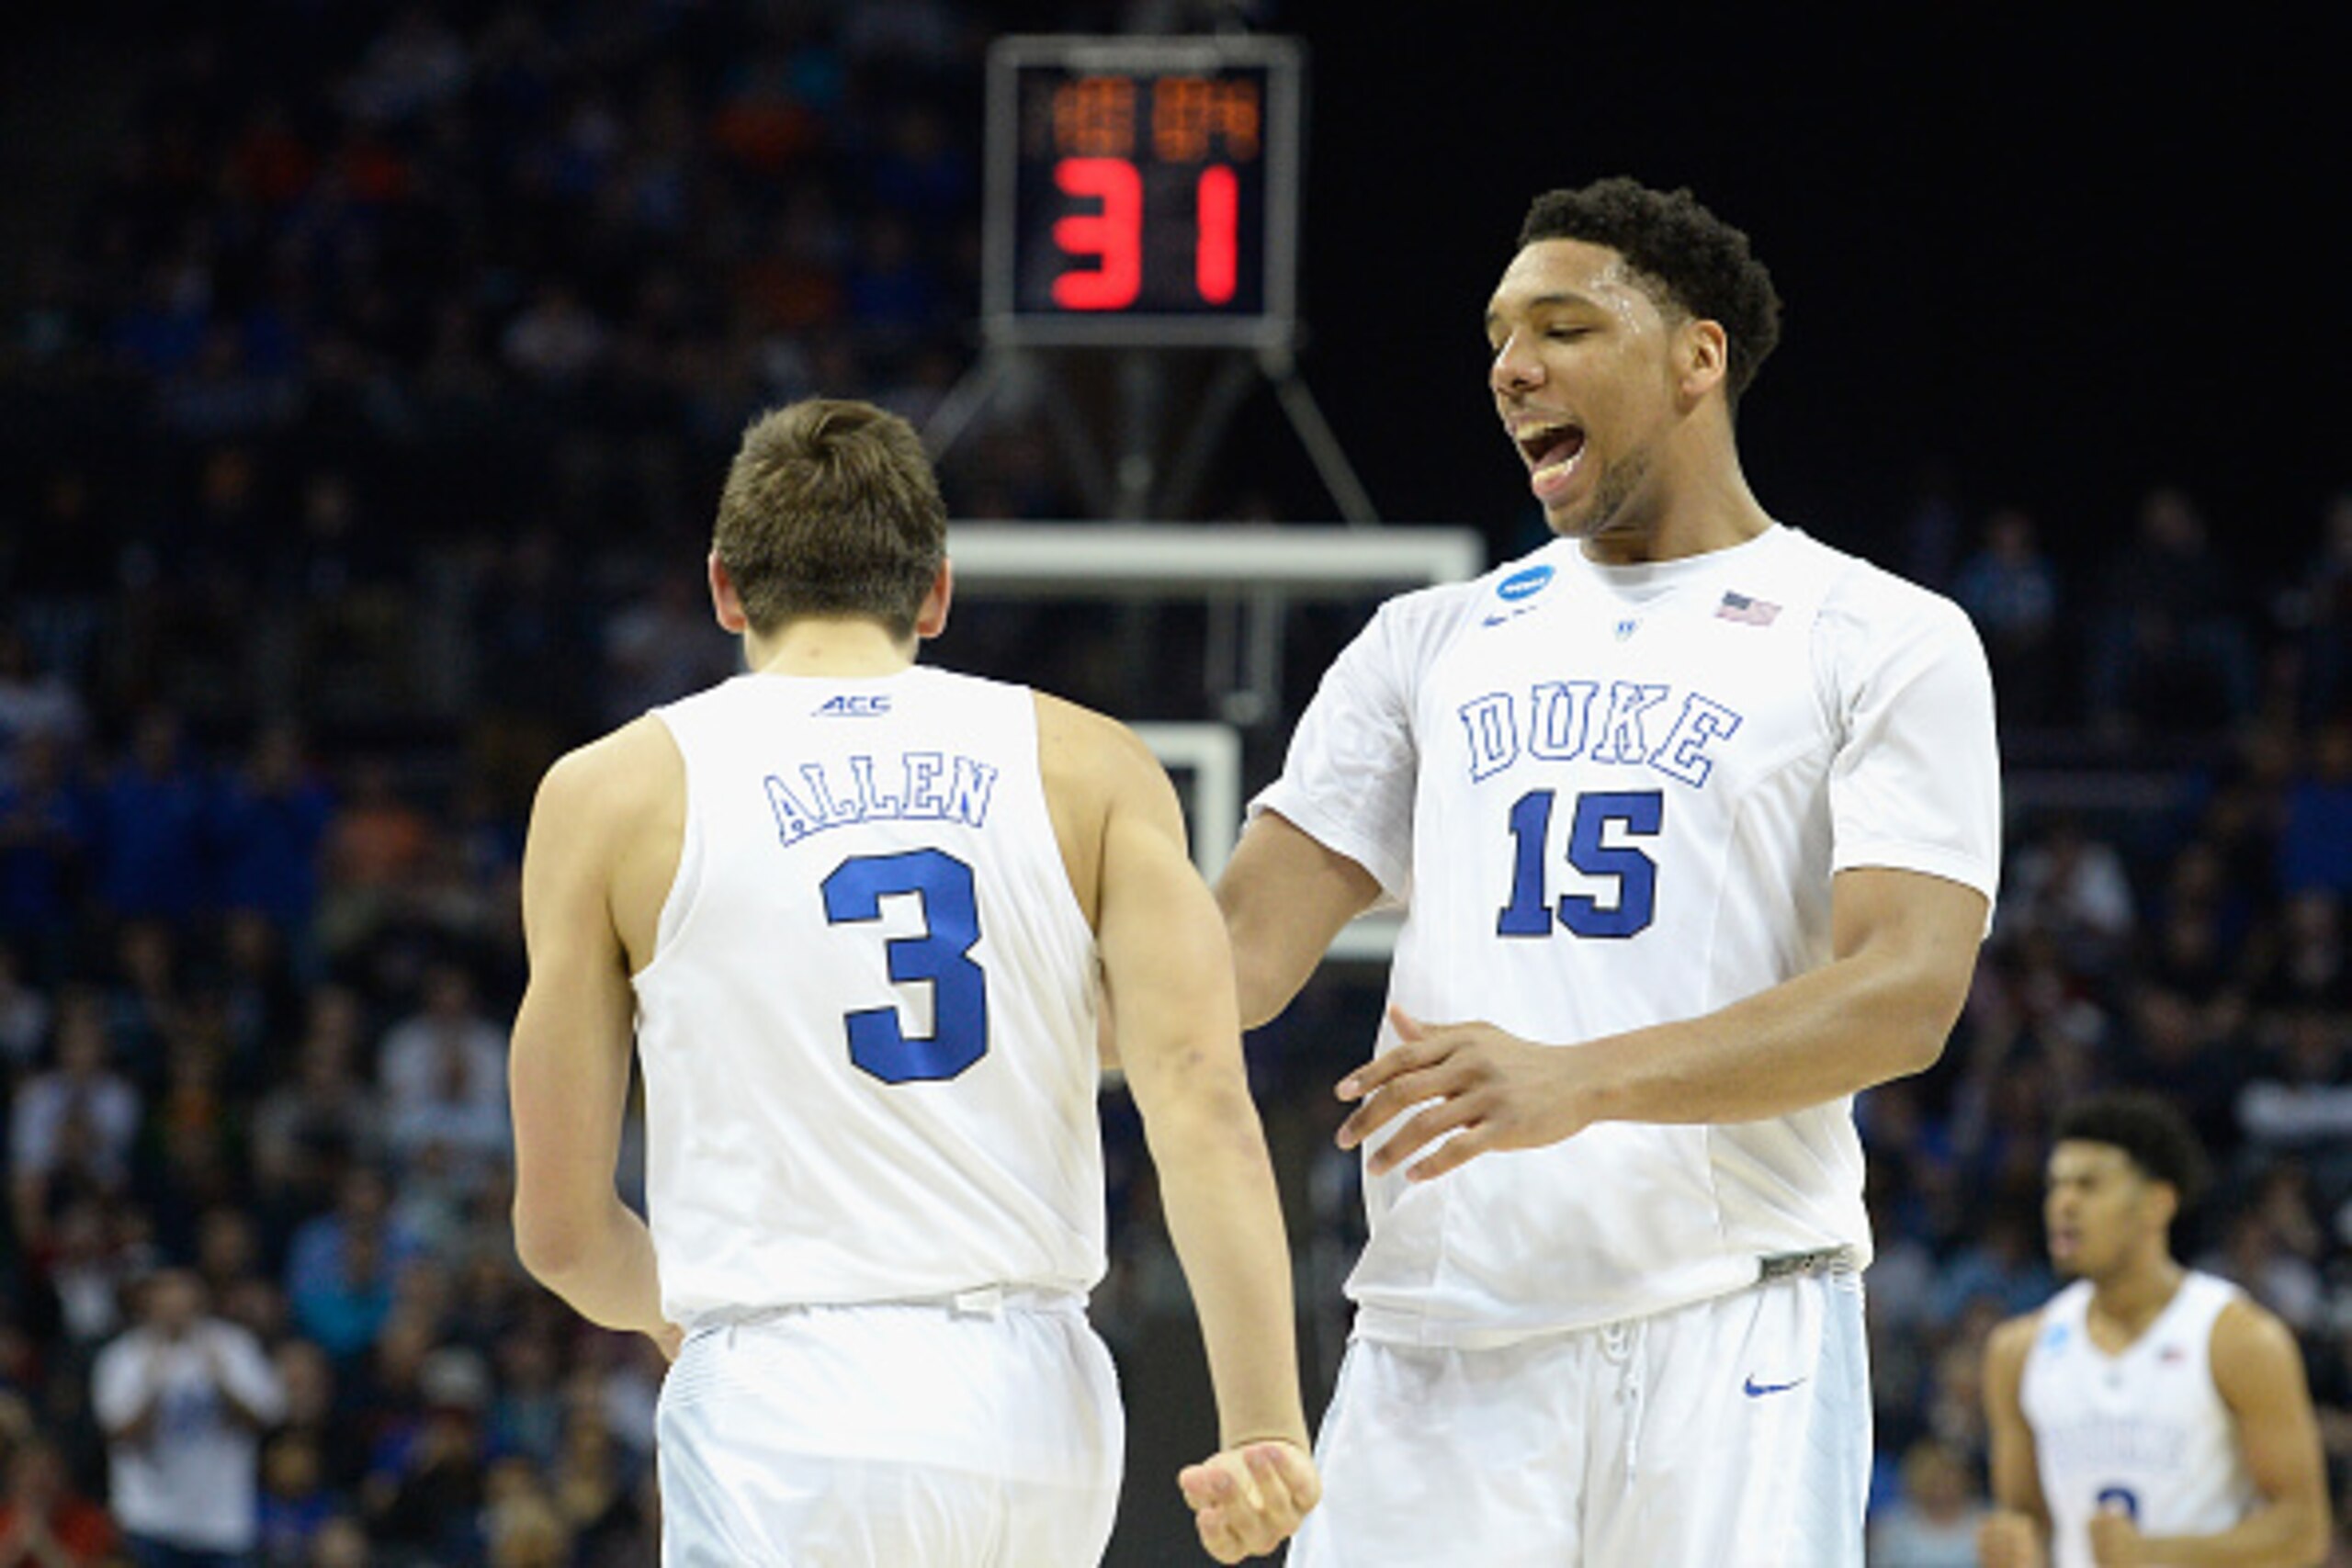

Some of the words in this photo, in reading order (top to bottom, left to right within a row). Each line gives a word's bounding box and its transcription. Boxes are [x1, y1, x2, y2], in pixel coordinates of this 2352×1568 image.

[1051, 157, 1238, 310] 31
[810, 695, 892, 717] ACC
[1458, 681, 1744, 789] DUKE
[763, 751, 999, 848] ALLEN
[1497, 788, 1664, 939] 15
[820, 847, 989, 1085] 3
